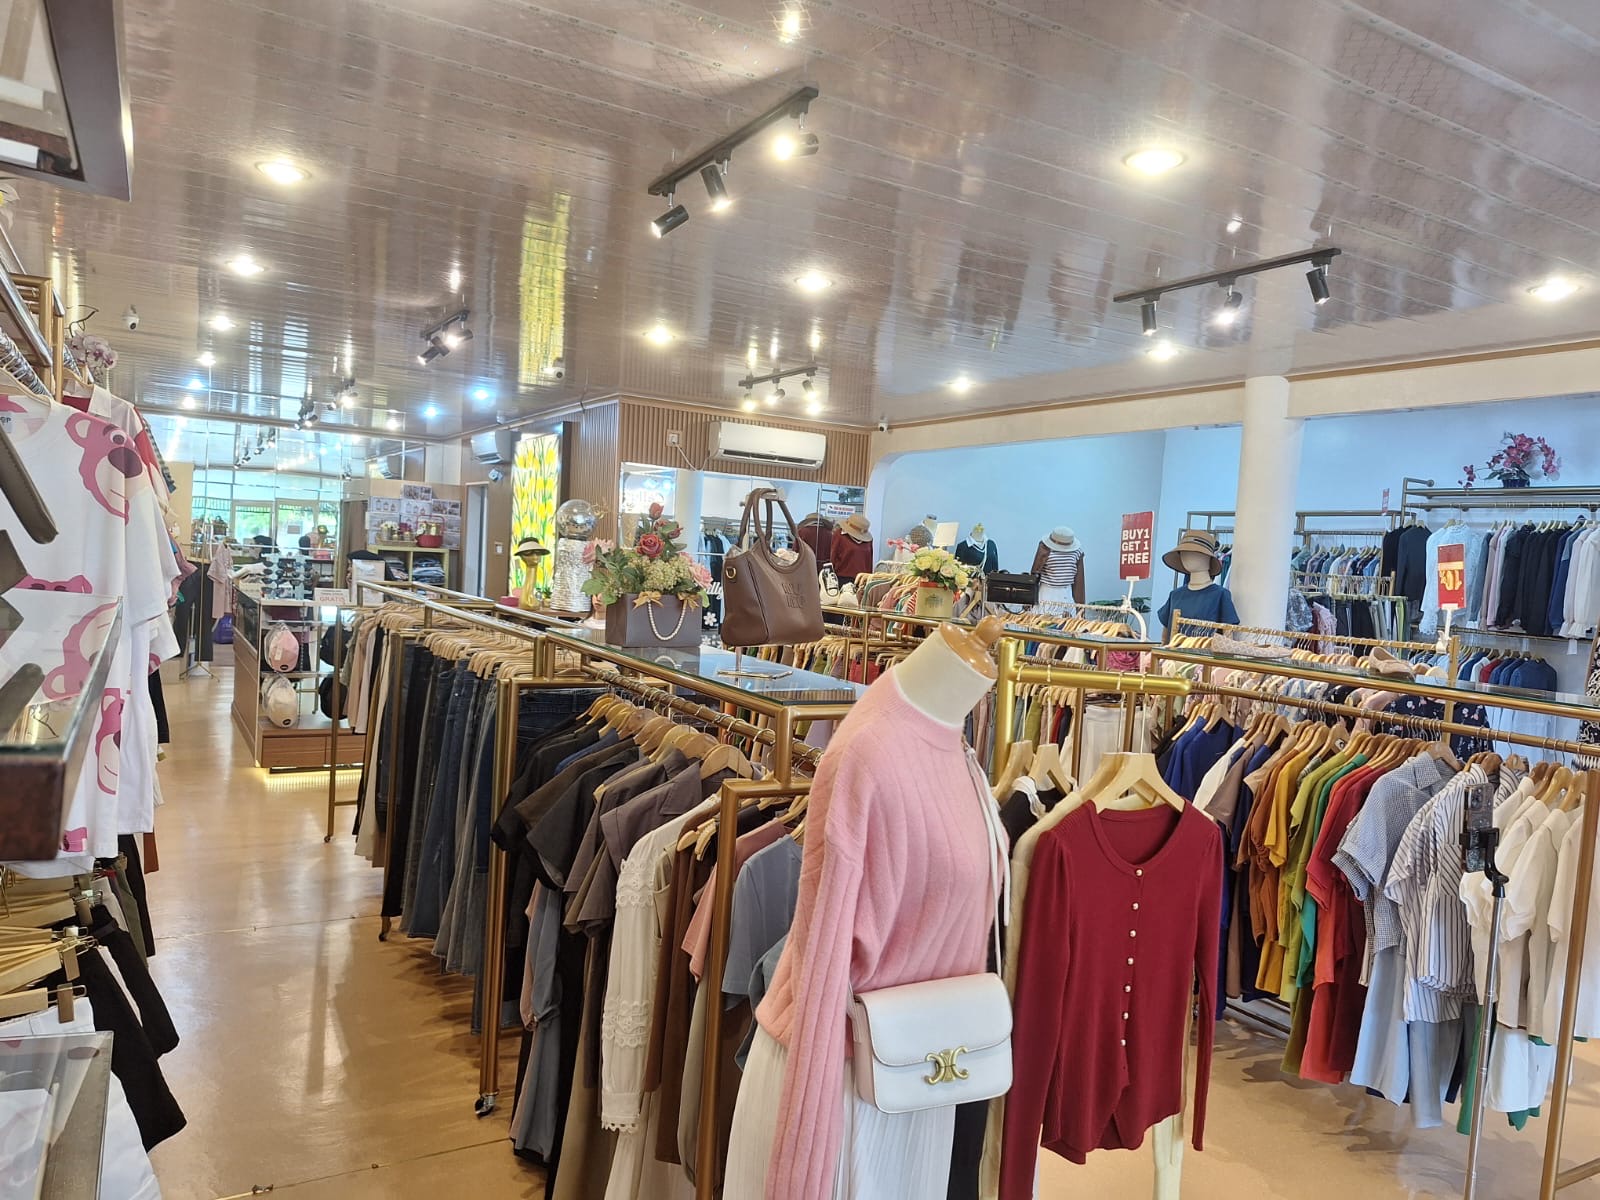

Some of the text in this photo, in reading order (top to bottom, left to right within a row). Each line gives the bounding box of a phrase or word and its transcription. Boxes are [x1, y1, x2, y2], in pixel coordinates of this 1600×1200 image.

[1121, 540, 1149, 551] GET 1
[1121, 552, 1149, 565] FREE
